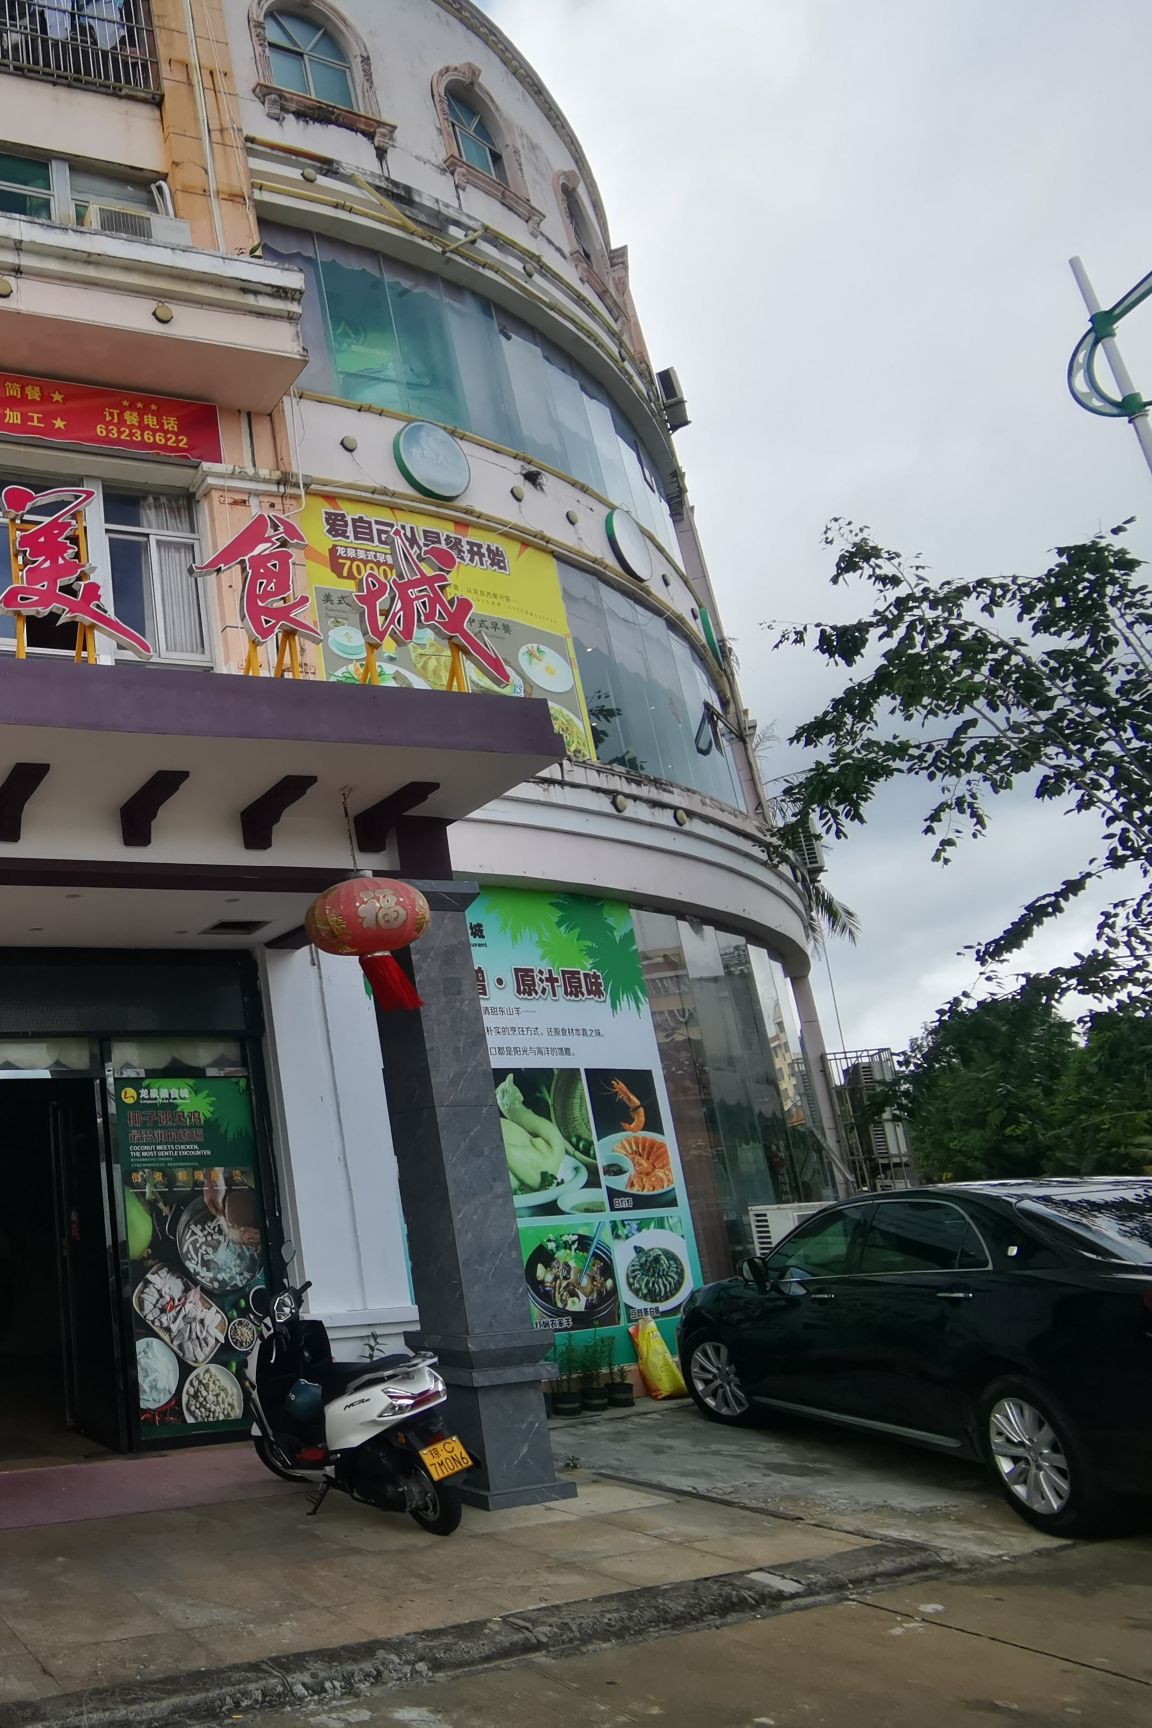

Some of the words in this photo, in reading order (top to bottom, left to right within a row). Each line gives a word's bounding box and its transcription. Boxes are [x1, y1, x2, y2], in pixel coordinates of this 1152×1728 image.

[103, 406, 179, 432] 订餐电话
[95, 424, 189, 448] 63236622
[338, 559, 396, 582] 7000
[357, 888, 408, 930] 福
